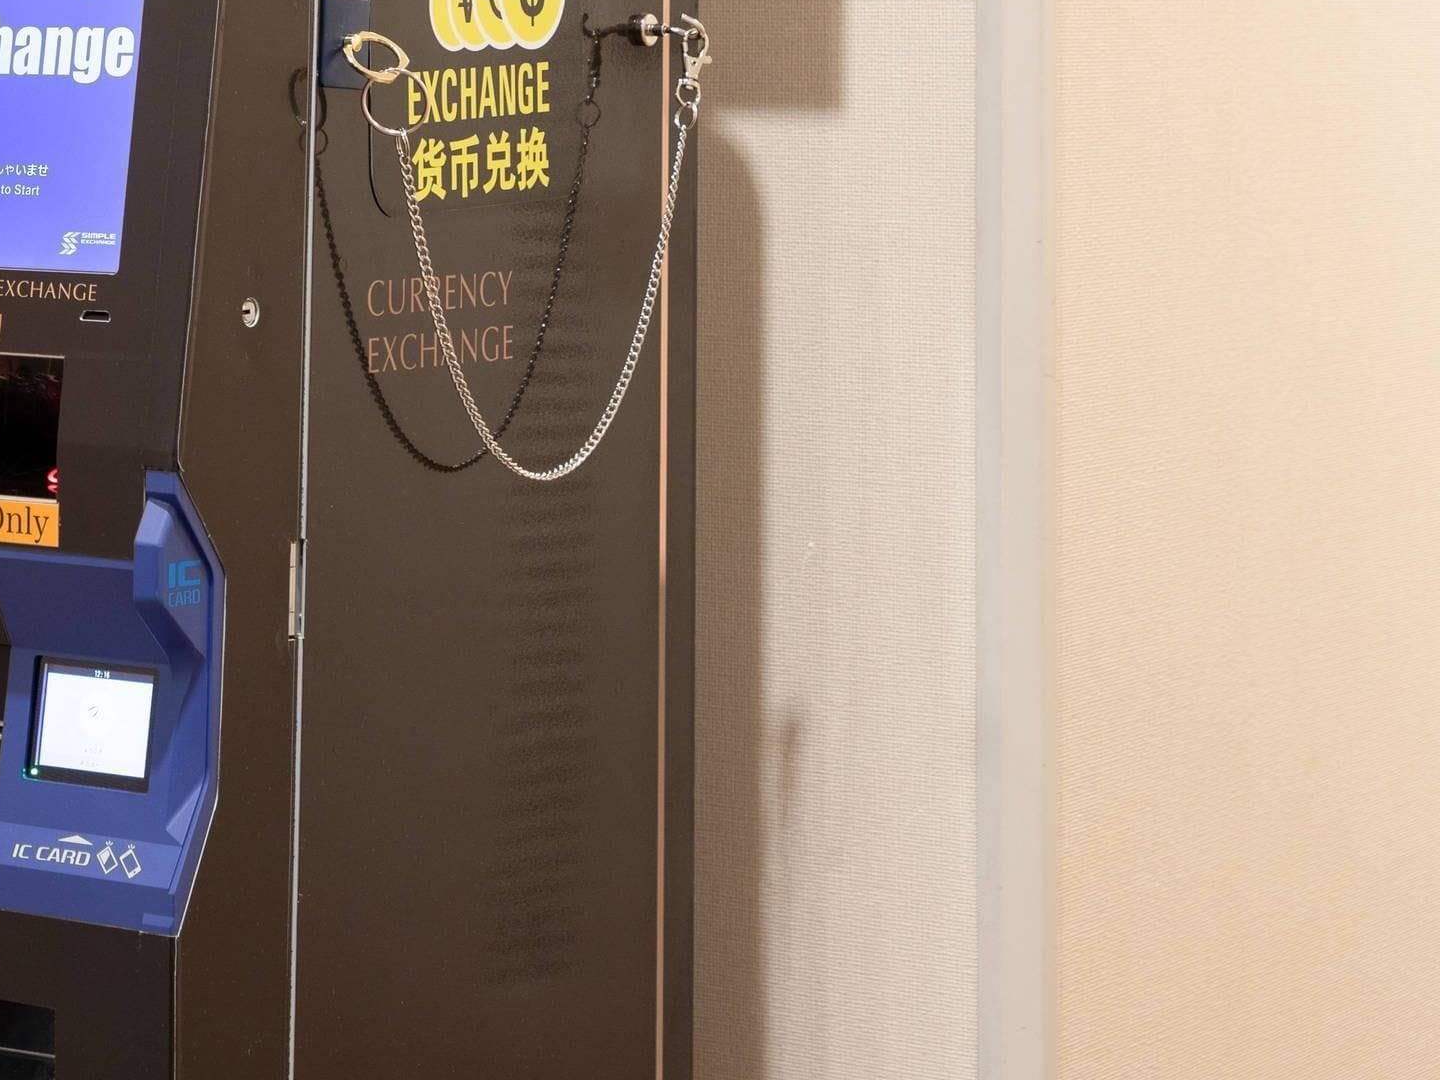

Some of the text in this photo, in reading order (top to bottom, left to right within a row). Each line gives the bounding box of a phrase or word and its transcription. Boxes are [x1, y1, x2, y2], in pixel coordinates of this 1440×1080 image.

[408, 61, 550, 125] EXCHANGE
[412, 127, 550, 202] 货币兑换
[1, 184, 11, 195] to
[14, 184, 40, 196] Start
[80, 232, 116, 240] SIMPLE
[168, 559, 201, 589] IC
[167, 587, 201, 607] CARD
[12, 843, 91, 866] IC CARD
